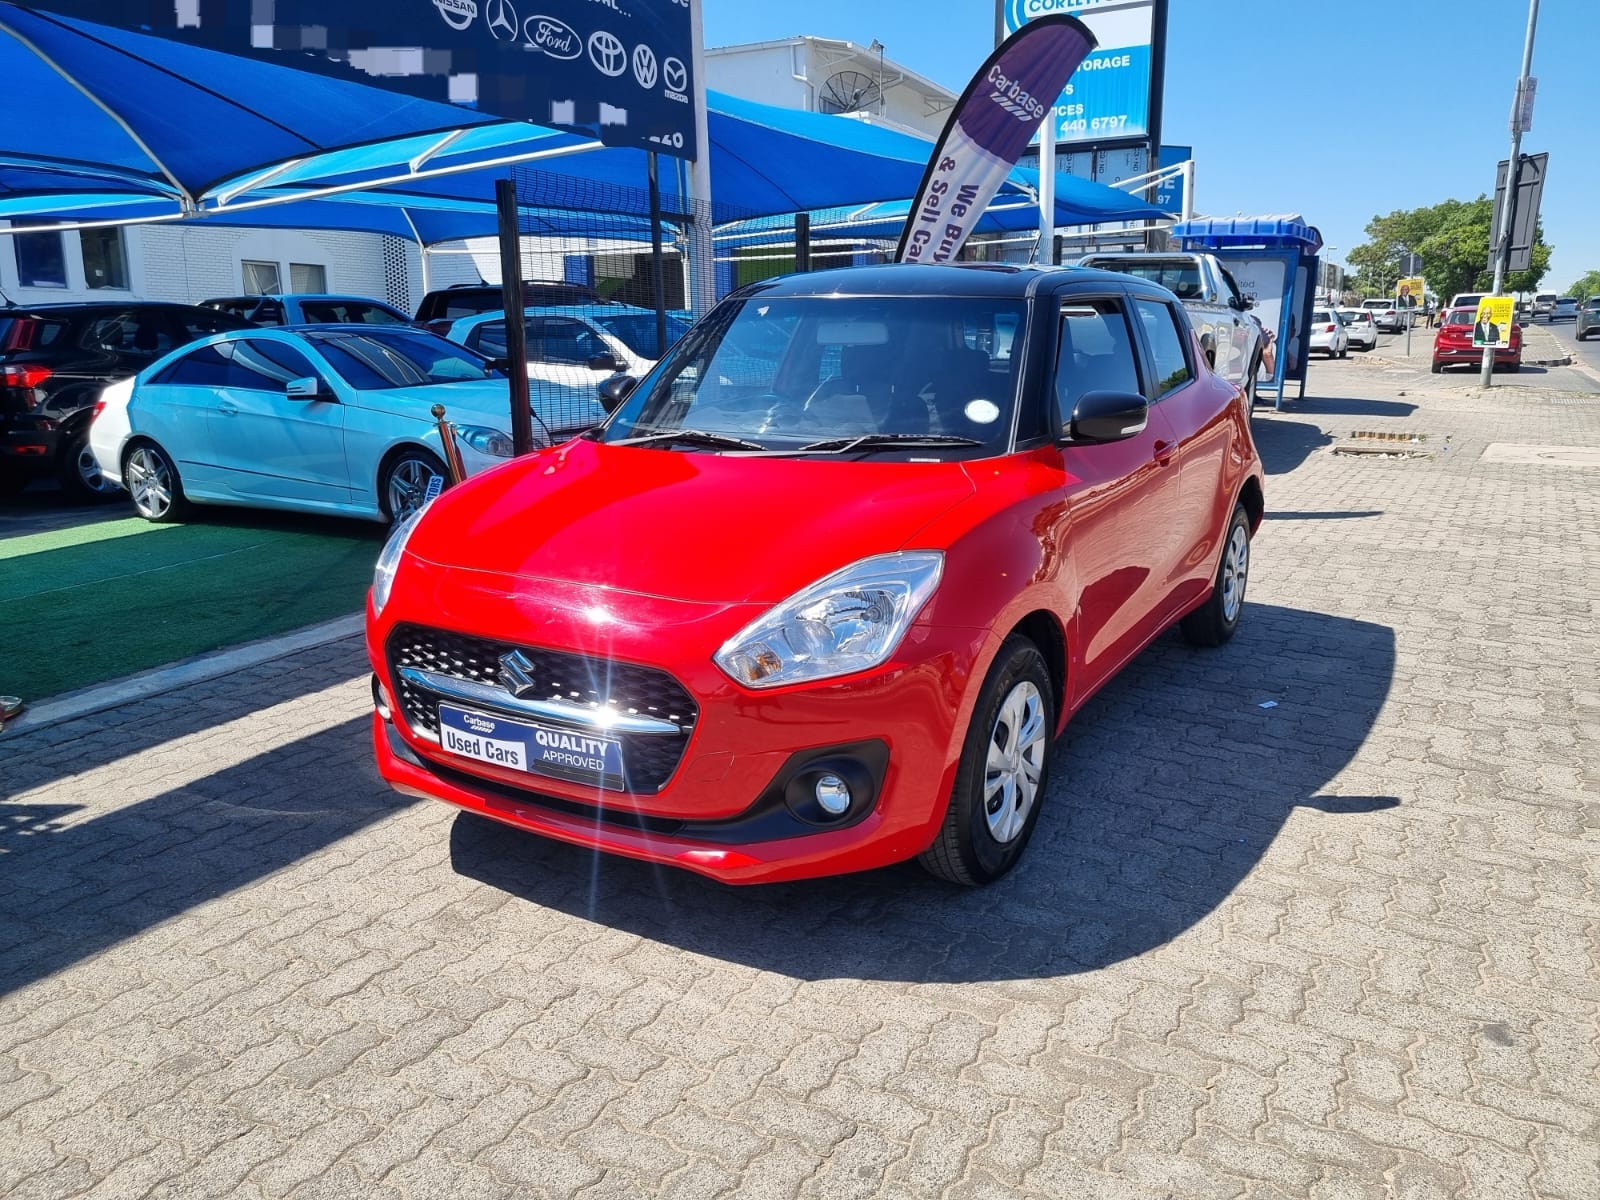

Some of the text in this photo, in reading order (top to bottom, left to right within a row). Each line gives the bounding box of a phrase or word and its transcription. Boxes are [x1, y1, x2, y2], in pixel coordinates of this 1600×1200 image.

[536, 21, 572, 53] Ford
[988, 65, 1044, 119] Carbase
[1060, 115, 1127, 132] 440 6797
[939, 156, 956, 173] &
[921, 179, 949, 224] Sell
[933, 184, 980, 263] We Buy
[426, 477, 442, 502] OTORS
[463, 714, 496, 730] Carbase
[446, 731, 519, 765] Used Cars
[535, 730, 608, 757] QUALITY
[542, 749, 605, 771] APPROVED
